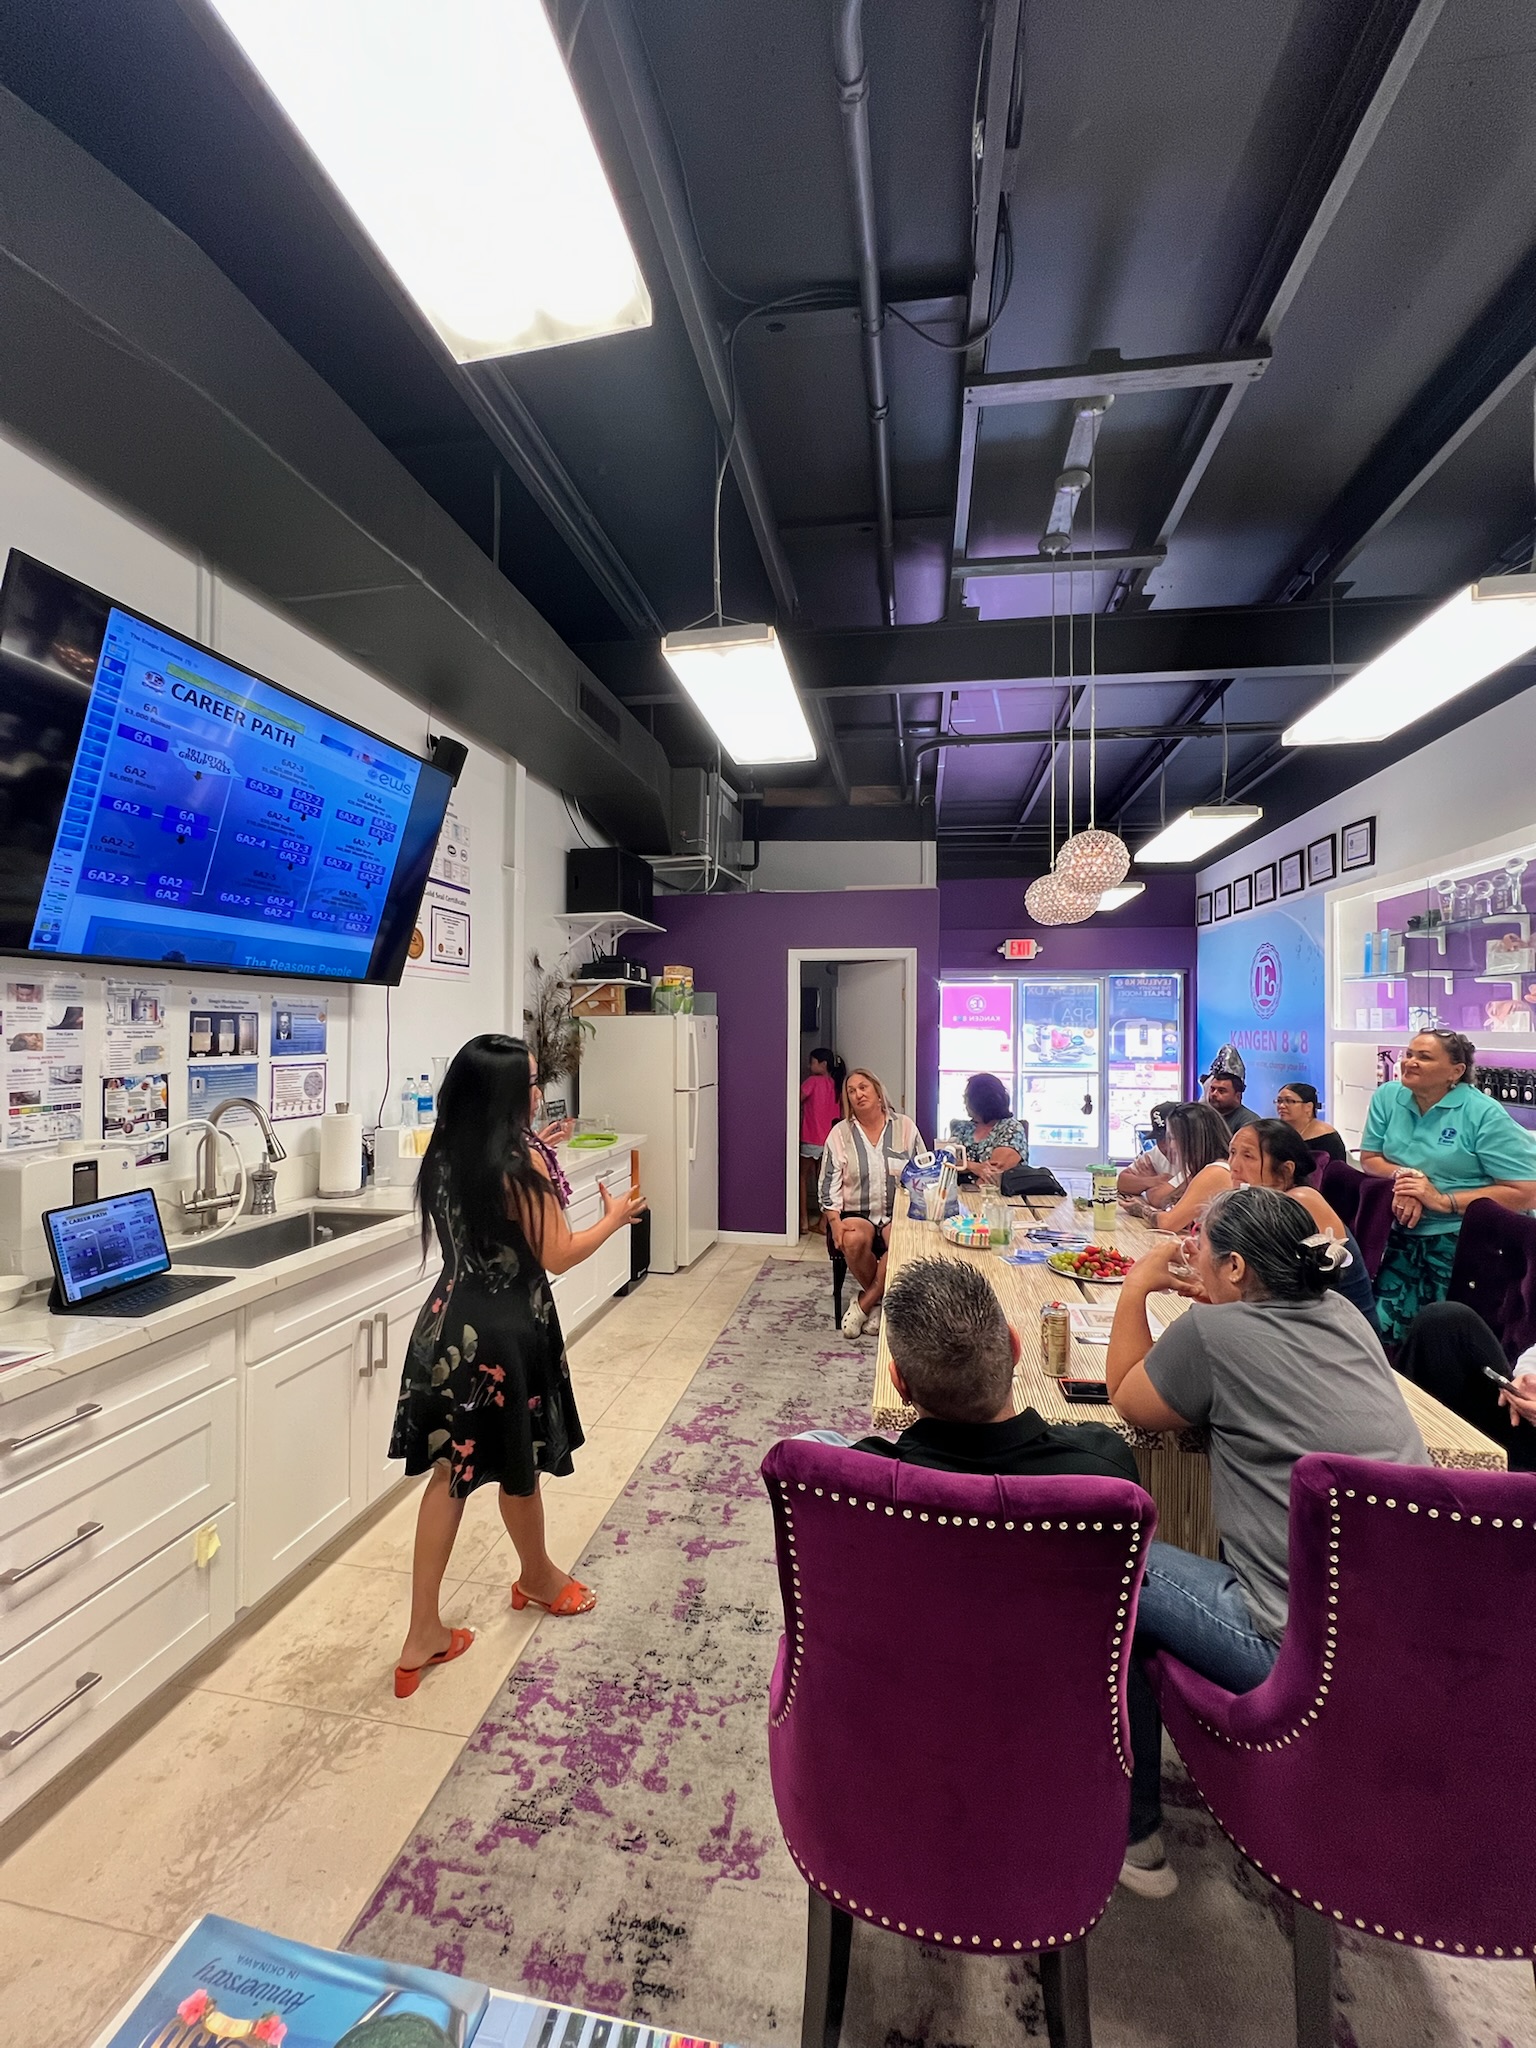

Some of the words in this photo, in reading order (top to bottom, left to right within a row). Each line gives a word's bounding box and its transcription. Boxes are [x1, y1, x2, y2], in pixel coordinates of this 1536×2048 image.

[130, 631, 140, 641] The
[160, 644, 183, 662] Business
[143, 703, 159, 716] 6A
[171, 683, 246, 728] CAREER
[250, 718, 296, 748] PATH
[134, 731, 153, 746] 6A
[124, 765, 147, 779] 6A2
[281, 759, 304, 773] 6A2-3
[379, 773, 412, 795] ews
[249, 780, 280, 797] 6A2-3
[294, 789, 321, 806] 6A2-2
[113, 799, 141, 816] 6A2
[179, 810, 195, 823] 6A
[292, 801, 319, 817] 6A2-2
[175, 823, 192, 836] 6A
[100, 835, 135, 850] 6A2-2
[236, 833, 267, 849] 6A2-4
[282, 839, 310, 854] 6A2-3
[279, 851, 307, 865] 6A2-3
[326, 857, 350, 871] 6A2-7
[87, 869, 130, 886] 6A2-2
[158, 875, 184, 889] 6A2
[155, 888, 180, 902] 6A2
[220, 892, 251, 906] 6A2-5
[267, 895, 295, 908] 6A2-4
[264, 907, 292, 919] 6A2-4
[1010, 940, 1032, 957] EXIT
[245, 956, 267, 969] The
[270, 958, 317, 974] Reasons
[318, 963, 353, 977] People
[1230, 1030, 1278, 1052] KANGEN
[236, 1953, 285, 1976] OKINAWA
[286, 1968, 300, 1980] IN
[192, 1957, 315, 2015] Anniversary
